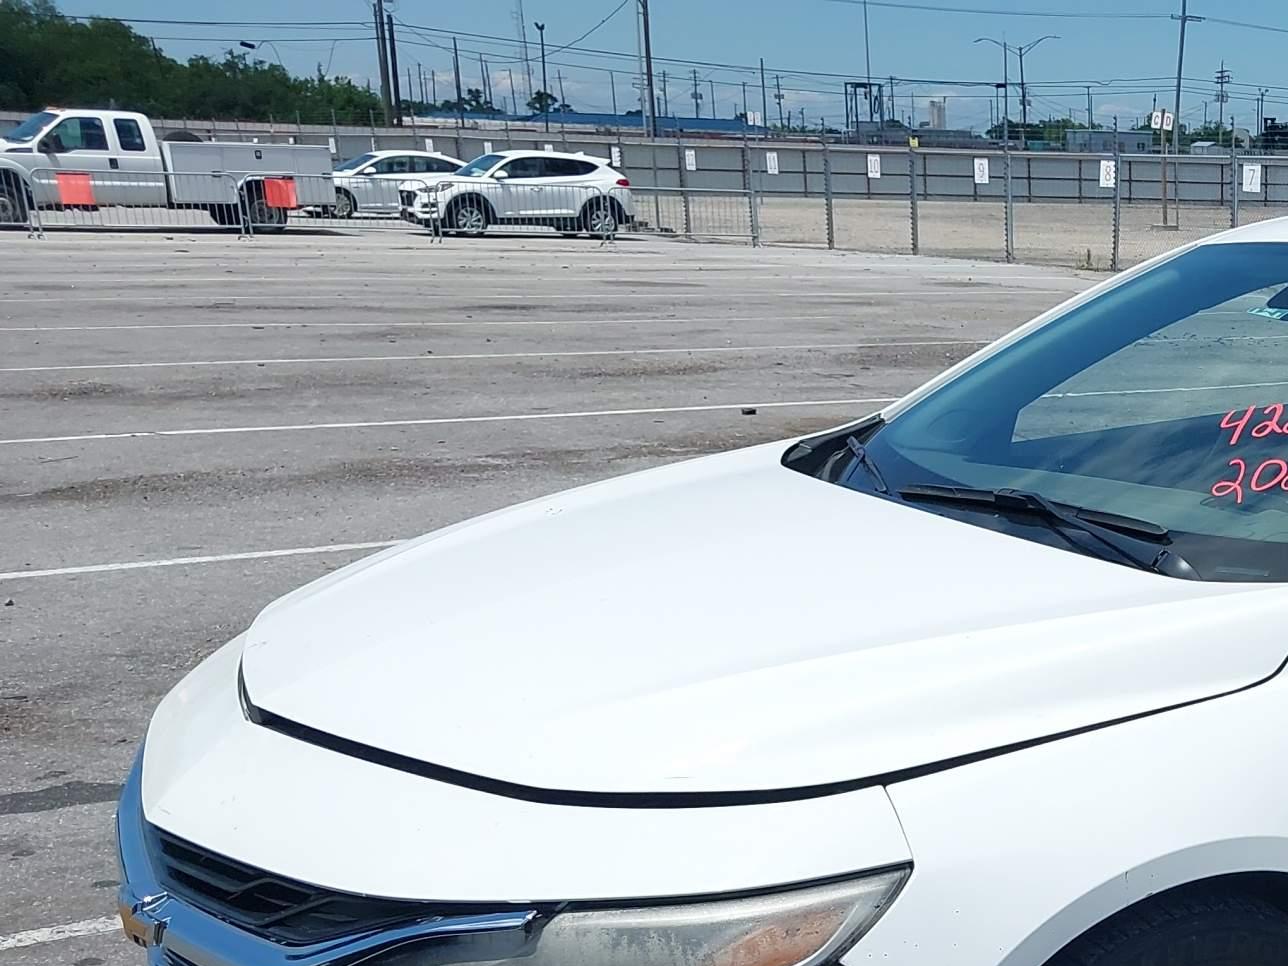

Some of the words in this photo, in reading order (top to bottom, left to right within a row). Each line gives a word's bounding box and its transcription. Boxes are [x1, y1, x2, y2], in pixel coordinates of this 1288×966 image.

[1153, 114, 1160, 126] C
[1165, 115, 1172, 127] D
[870, 158, 879, 174] 10
[977, 162, 985, 179] 9
[1104, 165, 1112, 182] 8
[1248, 168, 1257, 186] 7
